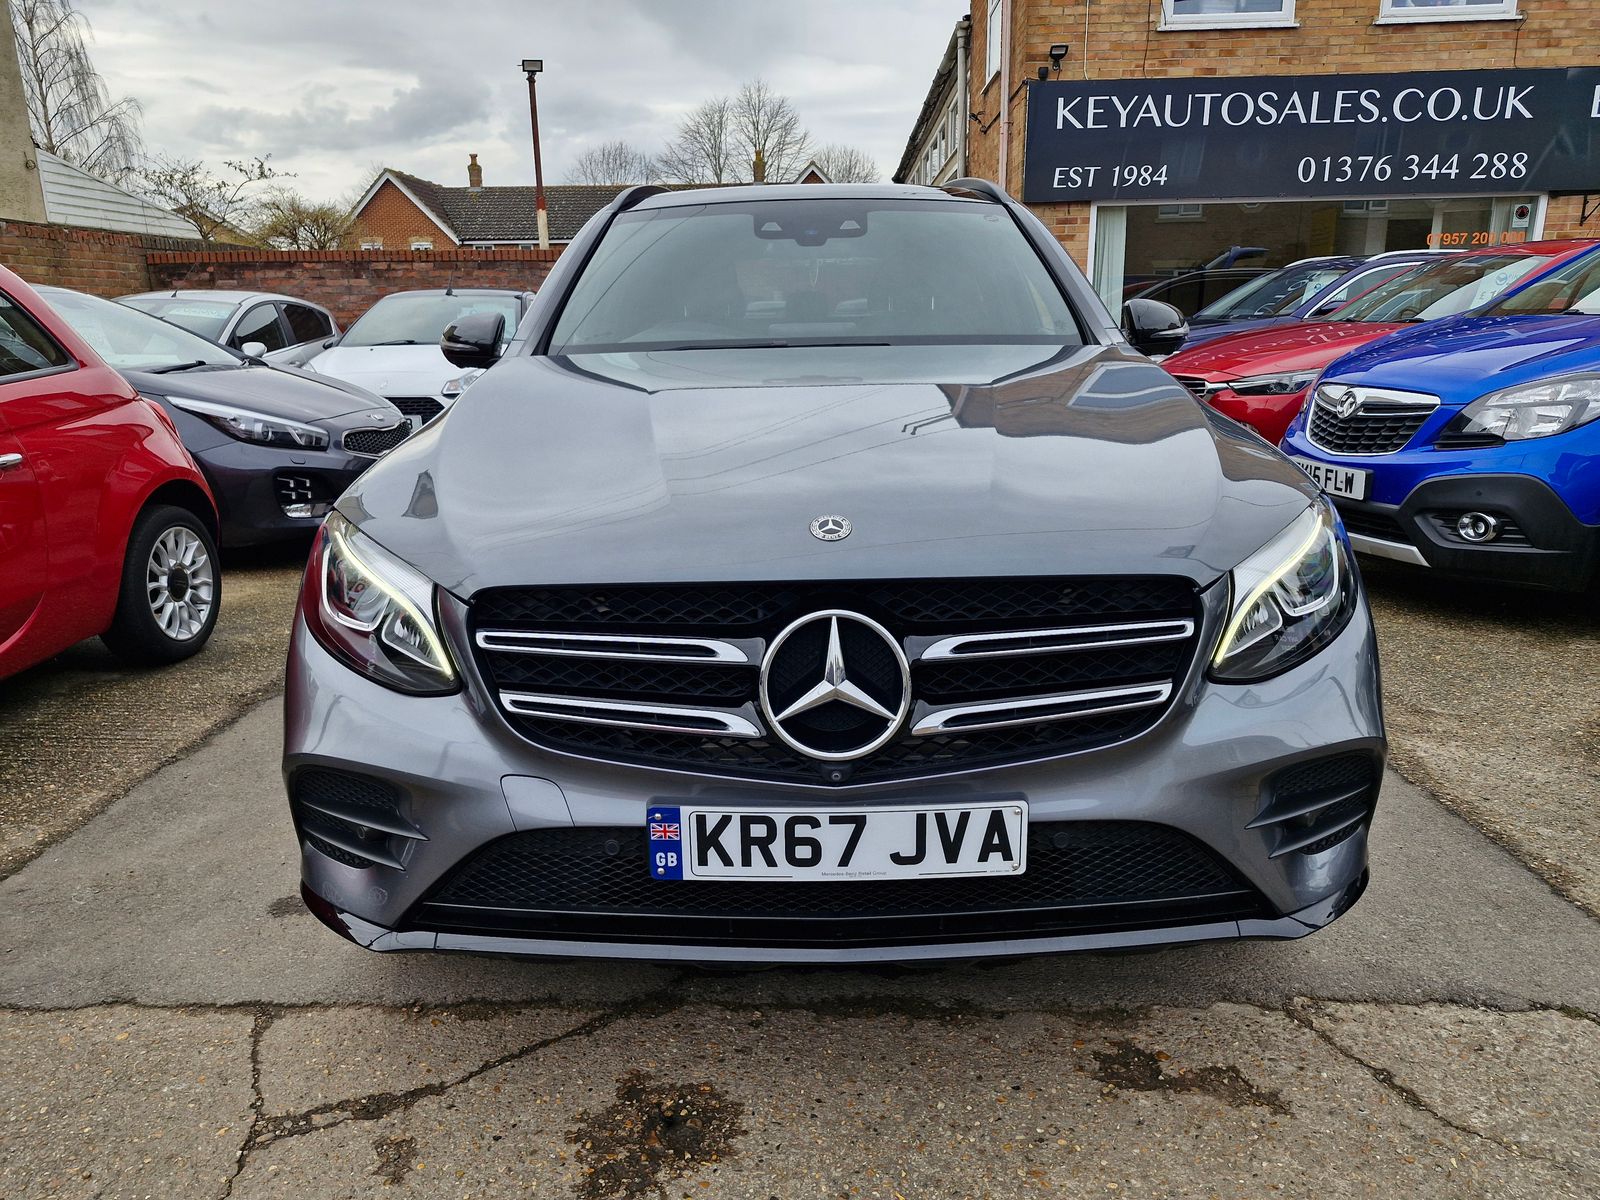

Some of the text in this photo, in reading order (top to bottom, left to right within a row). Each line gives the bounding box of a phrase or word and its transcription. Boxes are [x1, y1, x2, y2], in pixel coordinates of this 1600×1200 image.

[1055, 84, 1535, 129] KEYAUTOSALES.CO.UK
[1052, 163, 1168, 189] EST 1984
[1298, 151, 1529, 183] 01376 344 288
[1426, 232, 1468, 246] 07957
[695, 808, 1014, 868] KR67 JVA
[655, 851, 678, 867] GB
